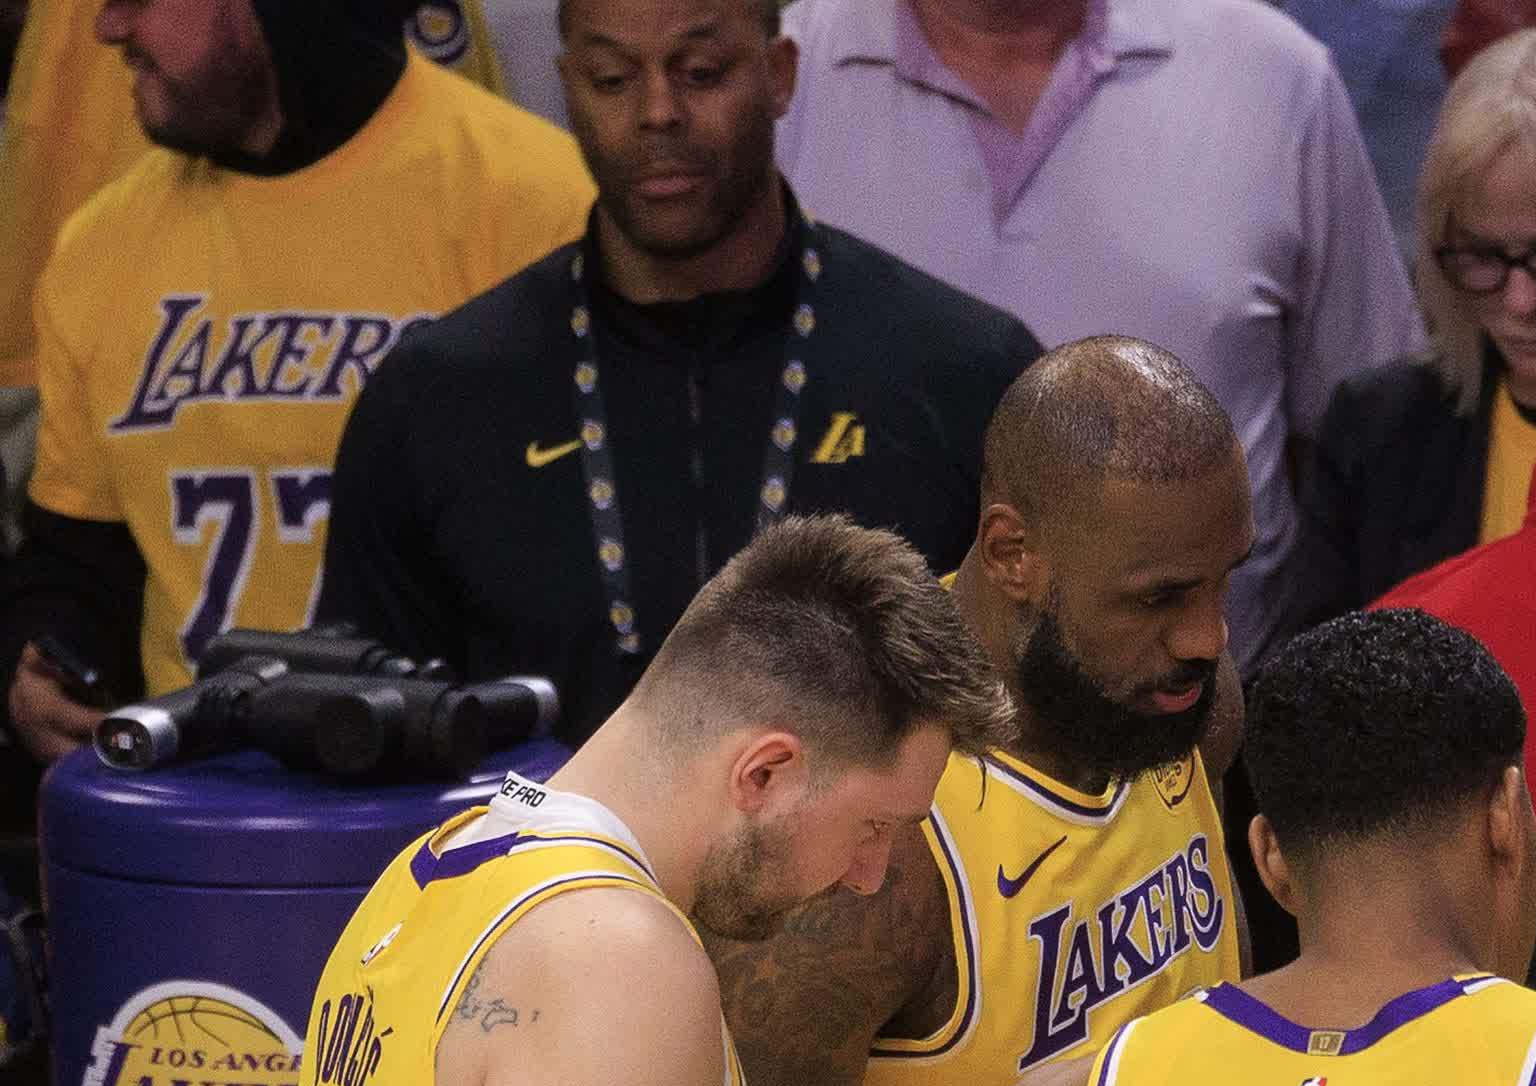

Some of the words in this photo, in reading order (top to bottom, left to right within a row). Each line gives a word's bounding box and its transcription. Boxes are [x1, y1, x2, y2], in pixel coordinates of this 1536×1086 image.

[106, 292, 440, 434] LAKER
[510, 785, 547, 808] PRO
[1017, 832, 1225, 1074] LAKERS
[150, 1046, 207, 1069] LOS
